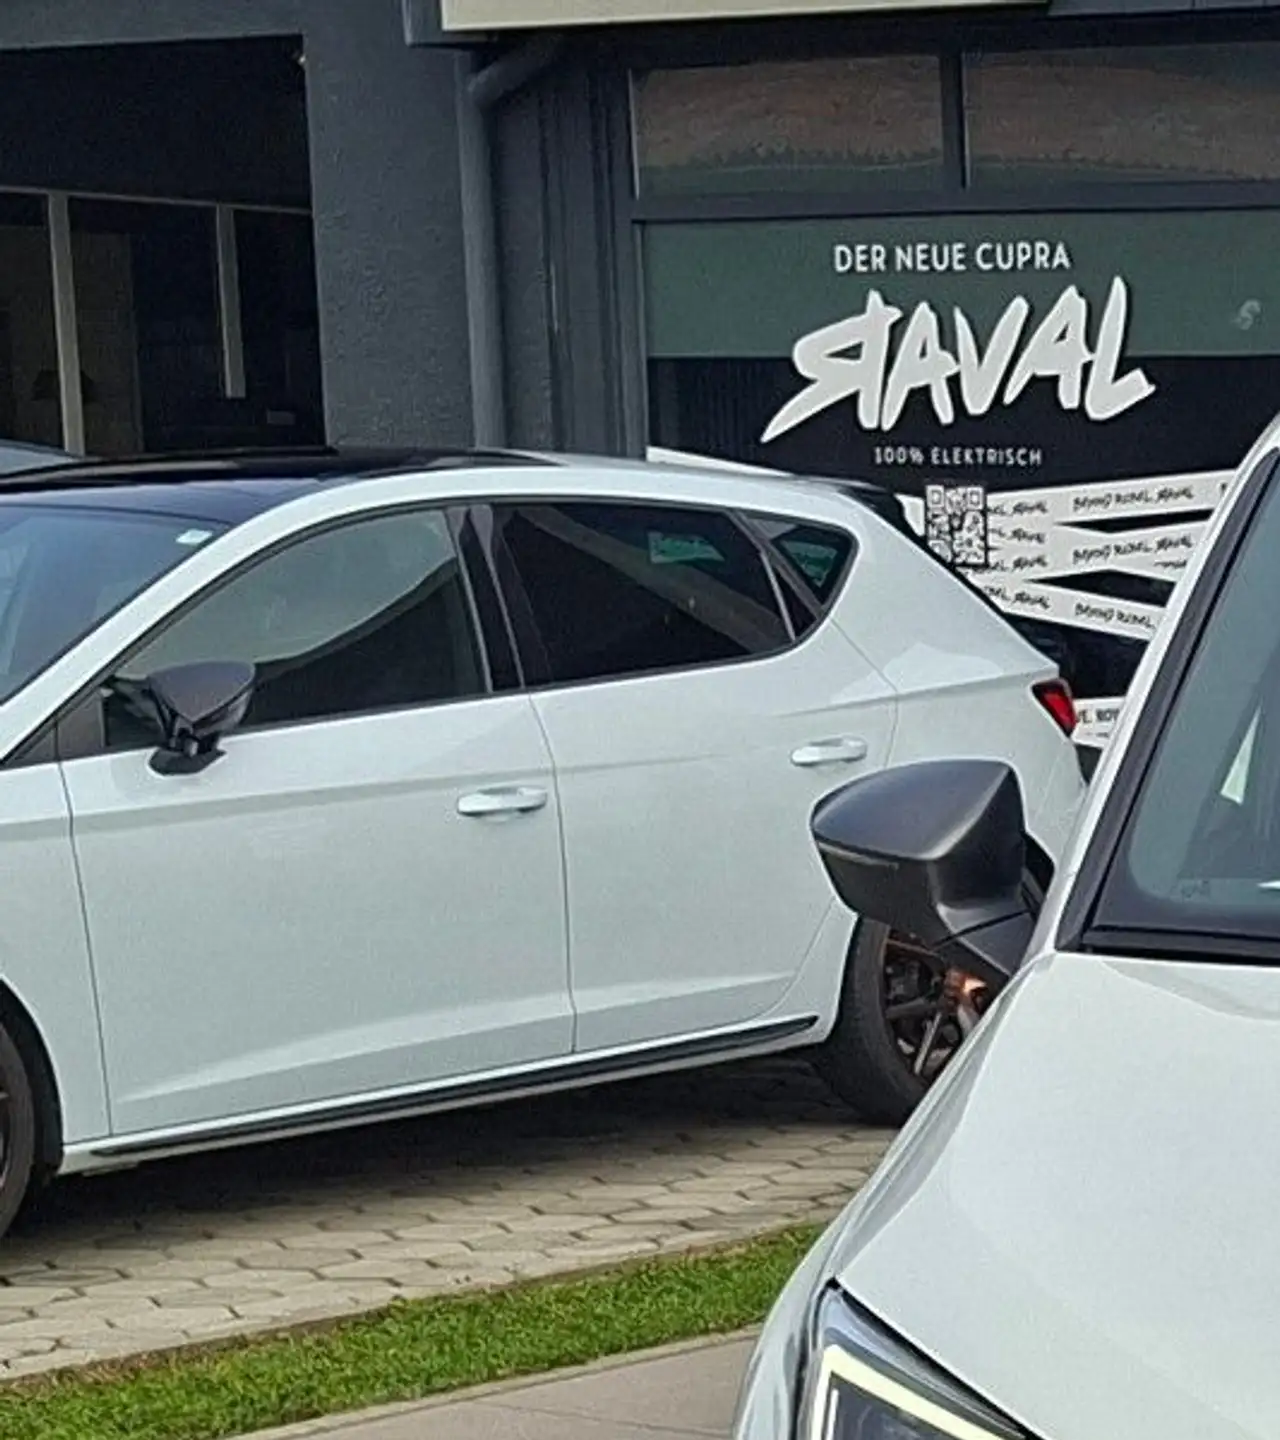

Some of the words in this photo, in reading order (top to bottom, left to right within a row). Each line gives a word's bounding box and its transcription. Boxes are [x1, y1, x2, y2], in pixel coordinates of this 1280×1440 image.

[834, 244, 887, 272] DER
[894, 242, 967, 271] NEUE
[975, 241, 1072, 270] CUPRA
[874, 446, 925, 466] 100%
[931, 446, 1043, 467] ELEKTRISCH
